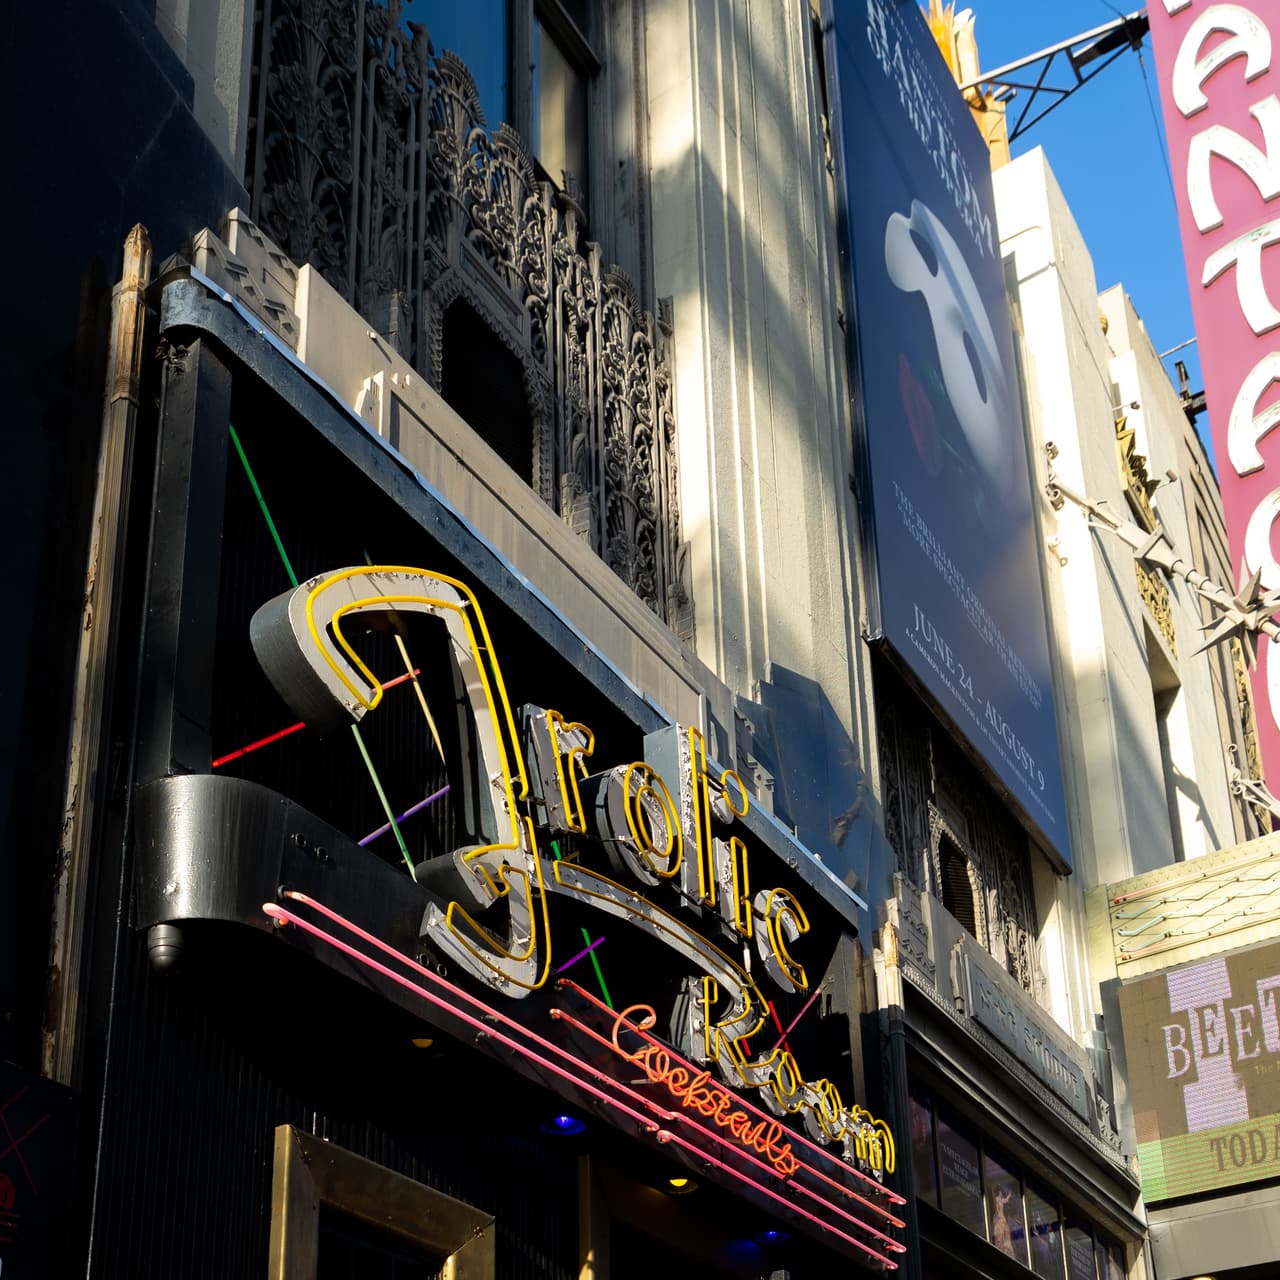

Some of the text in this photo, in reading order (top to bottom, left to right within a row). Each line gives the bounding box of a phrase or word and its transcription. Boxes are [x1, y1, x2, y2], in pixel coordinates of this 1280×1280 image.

[249, 564, 813, 1001] Frolic
[913, 602, 955, 676] JUNE
[958, 663, 975, 701] 24
[984, 699, 1039, 779] AUGUST
[688, 975, 898, 1177] Room
